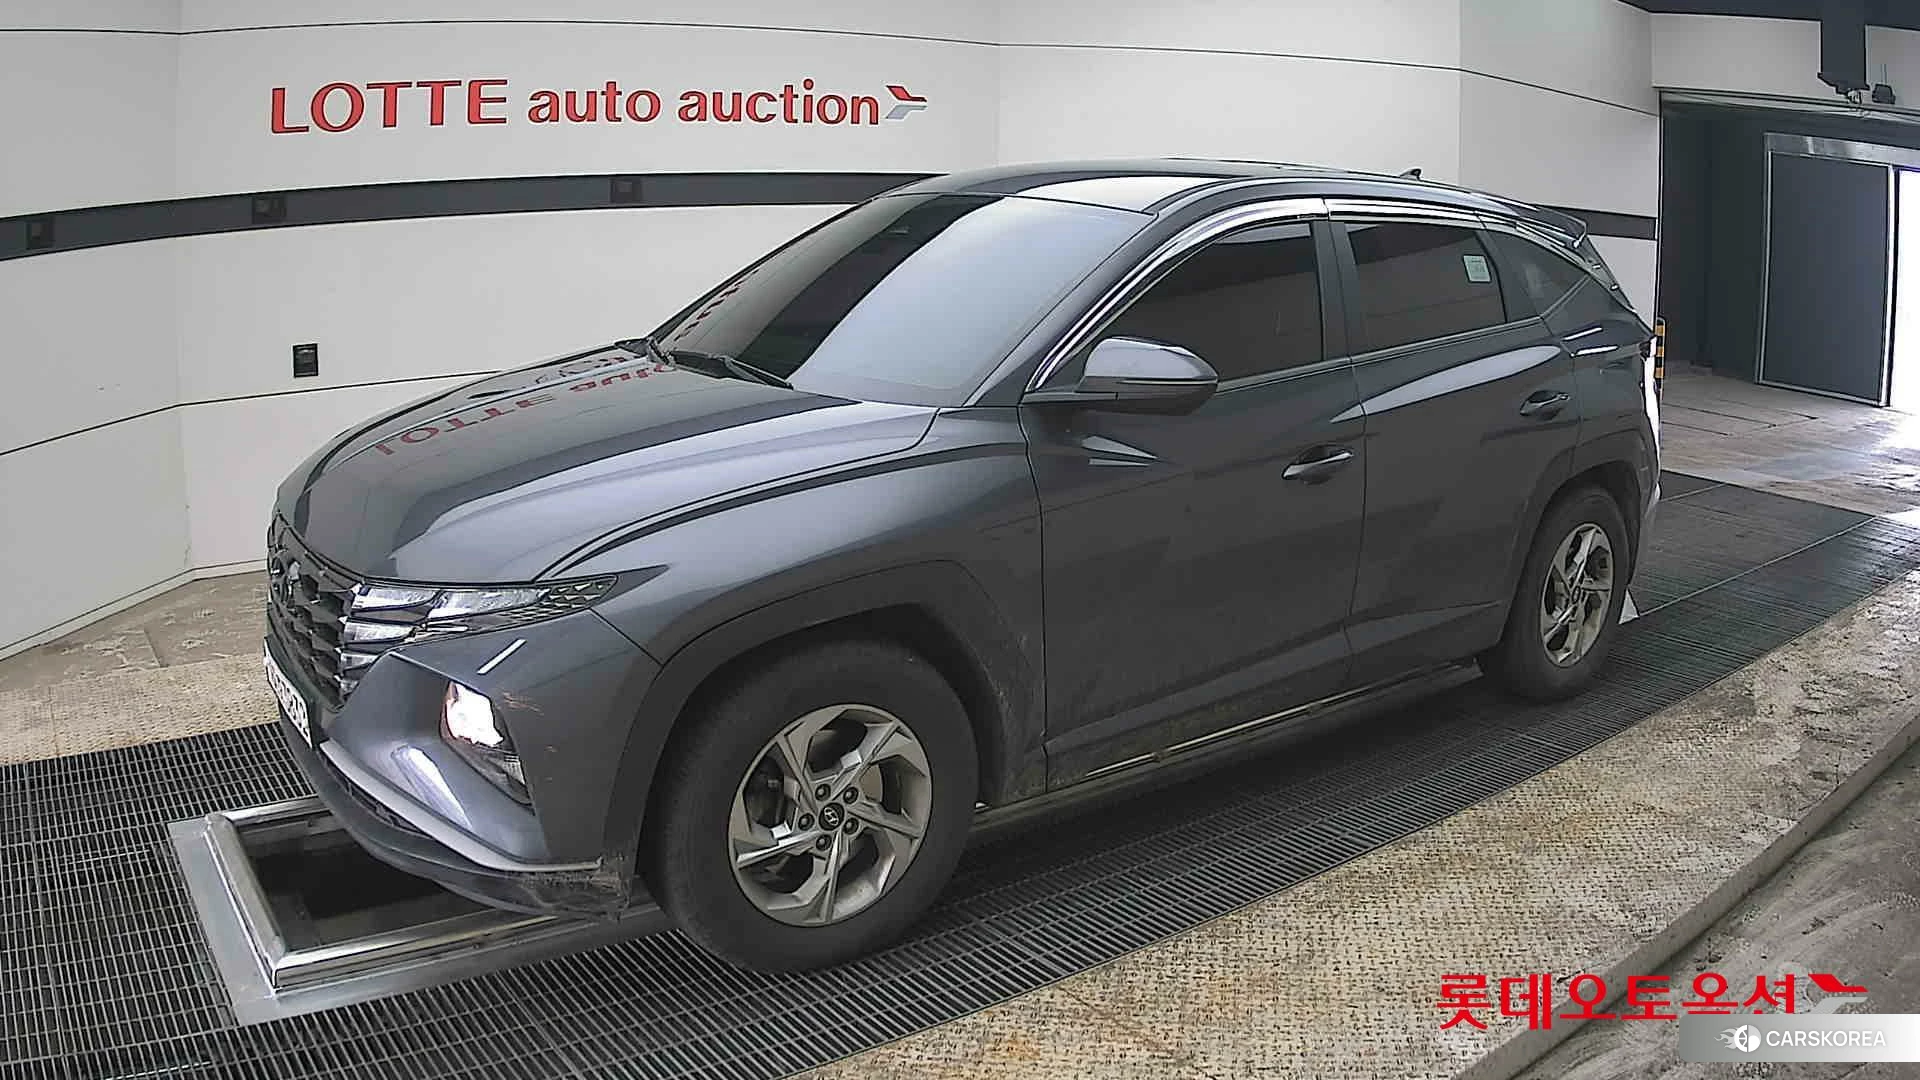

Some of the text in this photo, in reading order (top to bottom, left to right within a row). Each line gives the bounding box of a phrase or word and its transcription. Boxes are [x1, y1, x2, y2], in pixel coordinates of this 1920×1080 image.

[270, 79, 880, 134] LOTTE auto auction
